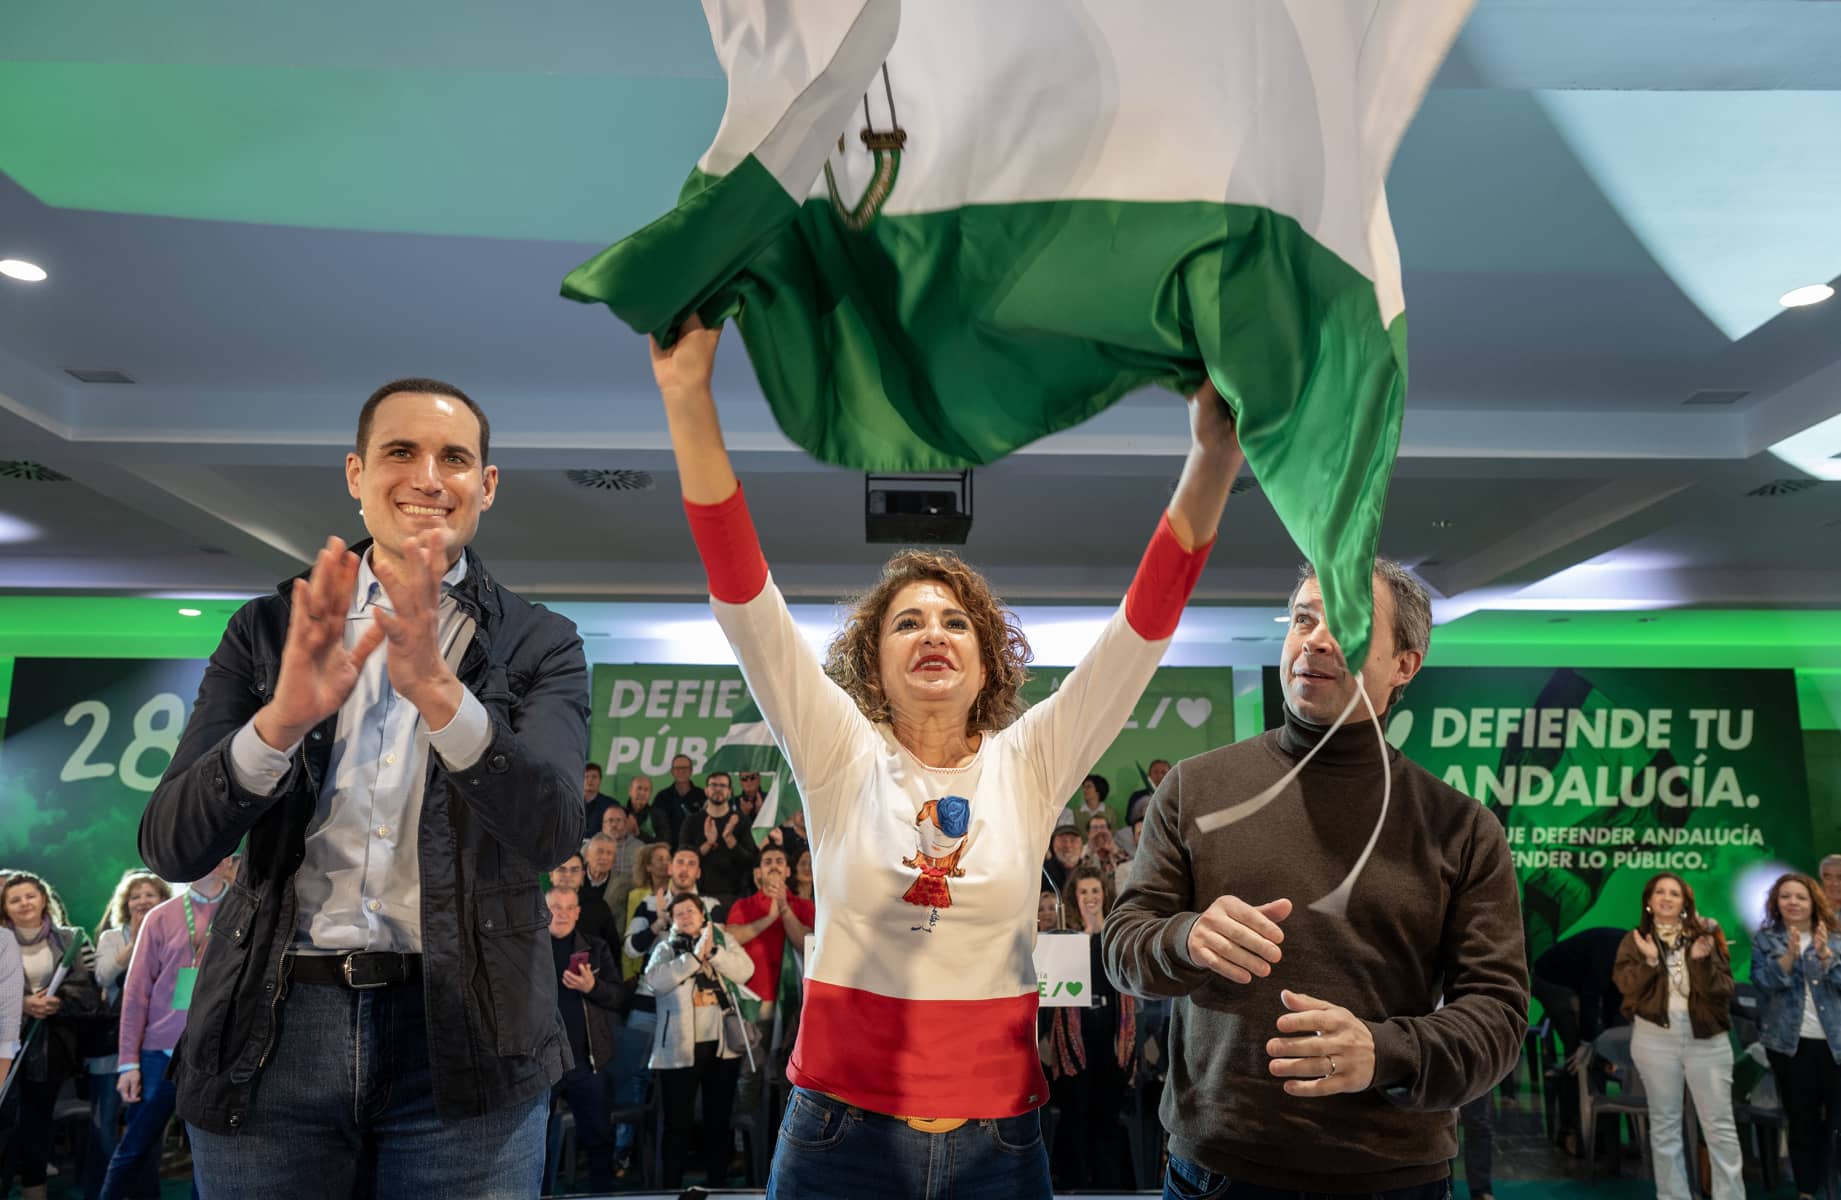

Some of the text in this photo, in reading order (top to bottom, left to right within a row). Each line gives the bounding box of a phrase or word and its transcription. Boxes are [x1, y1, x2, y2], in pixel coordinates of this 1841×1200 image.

[608, 679, 751, 718] DEFIE
[1430, 708, 1755, 751] DEFIENDE TU
[1531, 827, 1636, 845] DEFENDER
[1641, 824, 1765, 845] ANDALUCÍA
[1579, 851, 1608, 868] LO
[1613, 847, 1708, 869] PÚBLICO.
